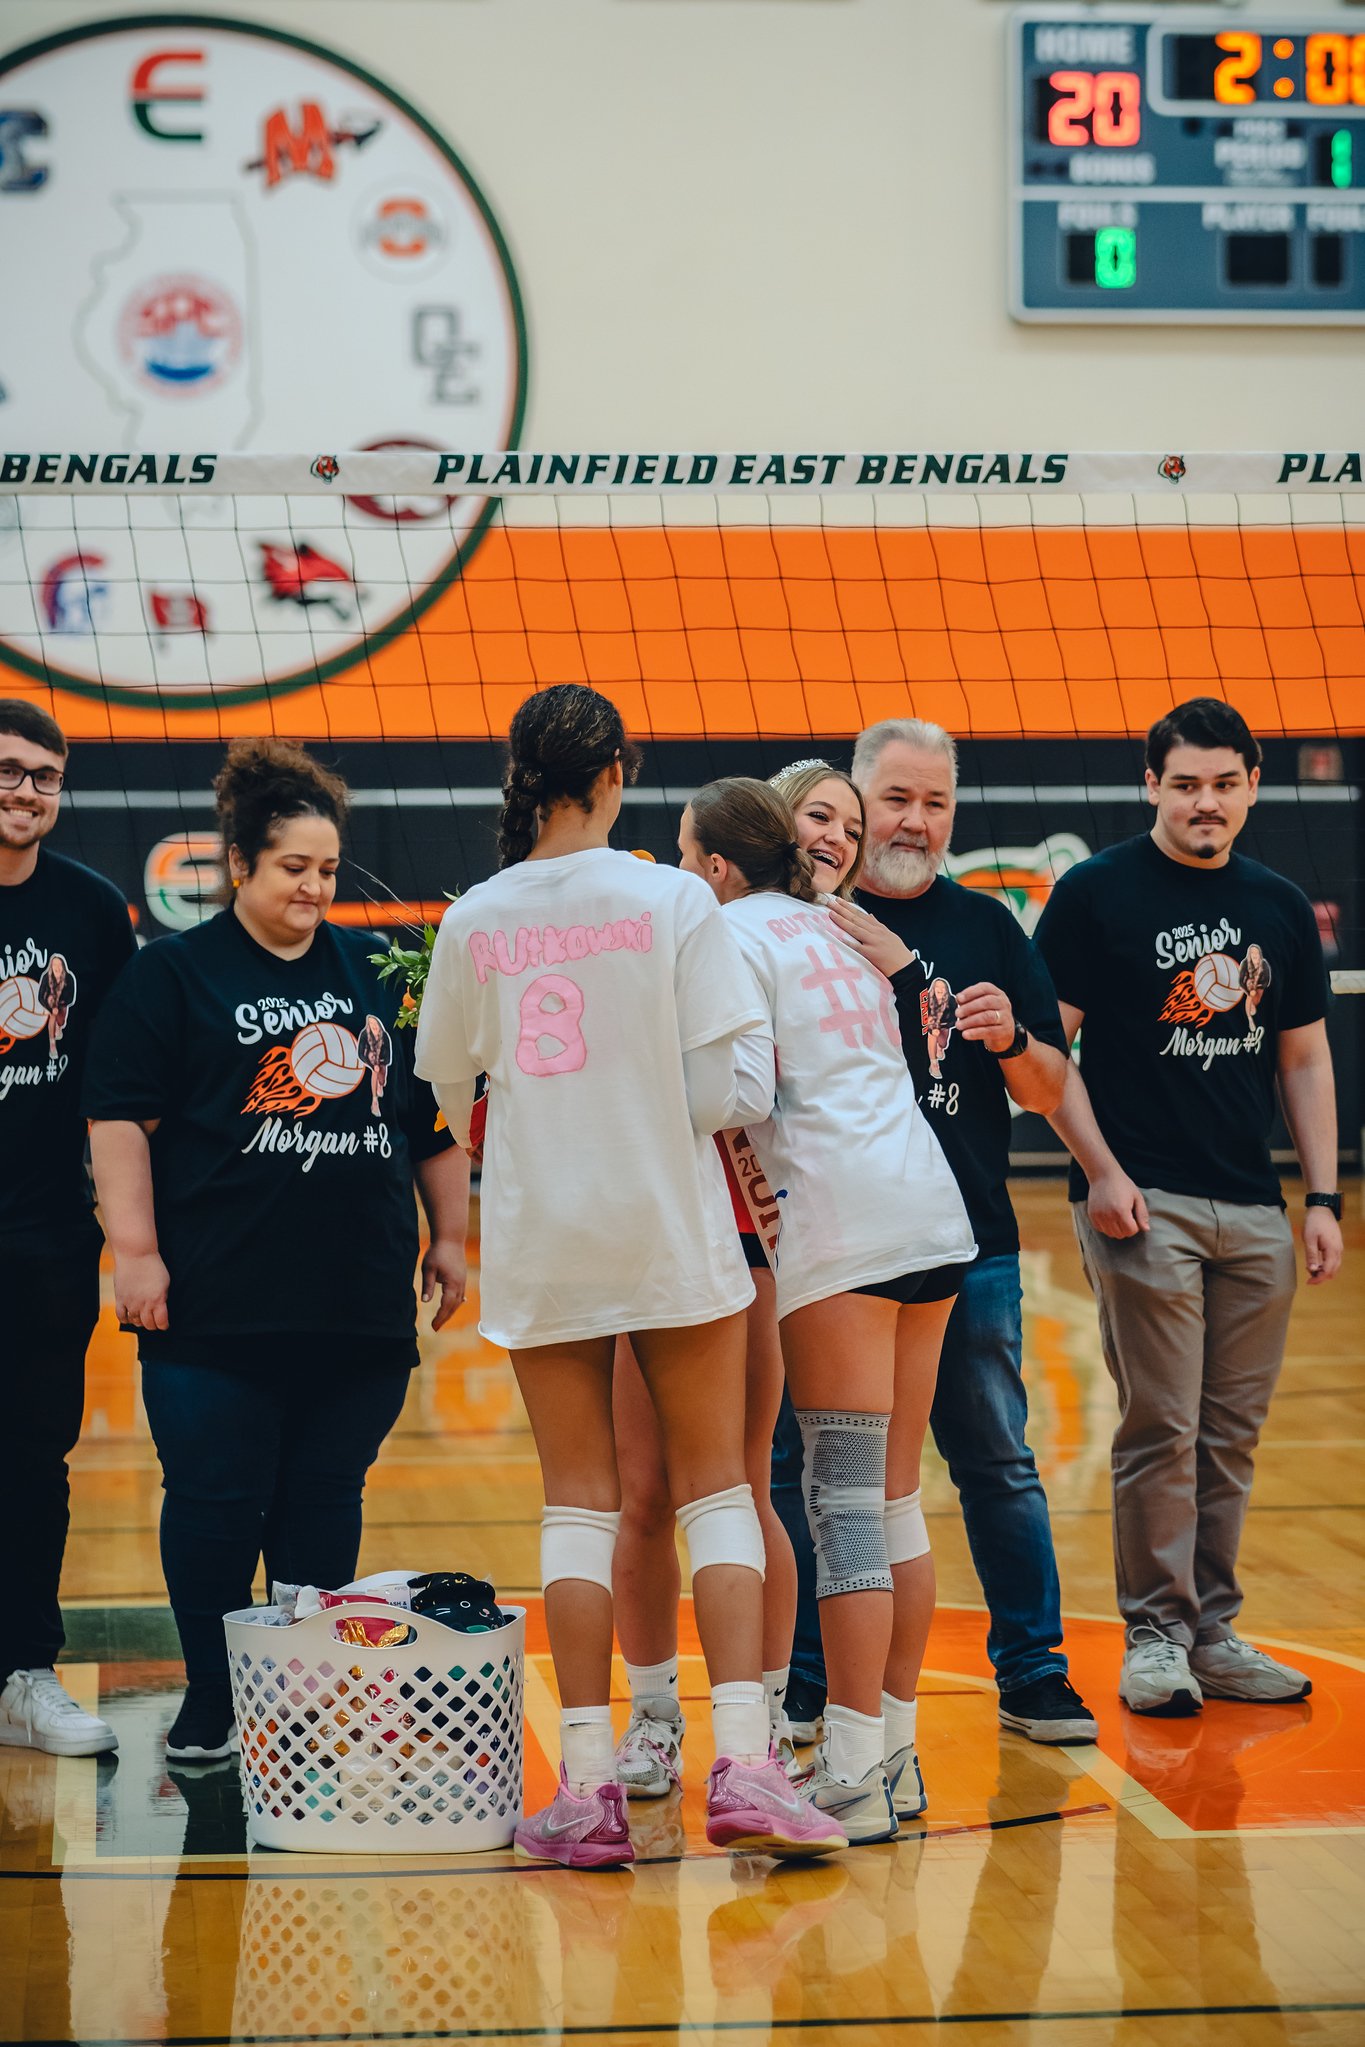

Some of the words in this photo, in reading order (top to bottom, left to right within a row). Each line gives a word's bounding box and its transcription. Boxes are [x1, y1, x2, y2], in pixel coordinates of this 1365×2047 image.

[1048, 70, 1141, 147] 20
[1331, 129, 1353, 189] 1
[1095, 226, 1136, 288] 0
[0, 454, 218, 484] BENGALS
[433, 454, 720, 484] PLAINFIELD
[729, 454, 846, 484] EAST
[855, 454, 1069, 484] BENGALS
[1154, 917, 1242, 970] Senior
[235, 991, 354, 1045] Senior
[257, 997, 290, 1011] 2025
[515, 973, 588, 1078] 8
[1159, 1026, 1242, 1071] Morgan
[0, 1064, 43, 1101] gan
[927, 1082, 961, 1116] #8
[241, 1116, 360, 1173] Morgan
[363, 1122, 392, 1159] #8
